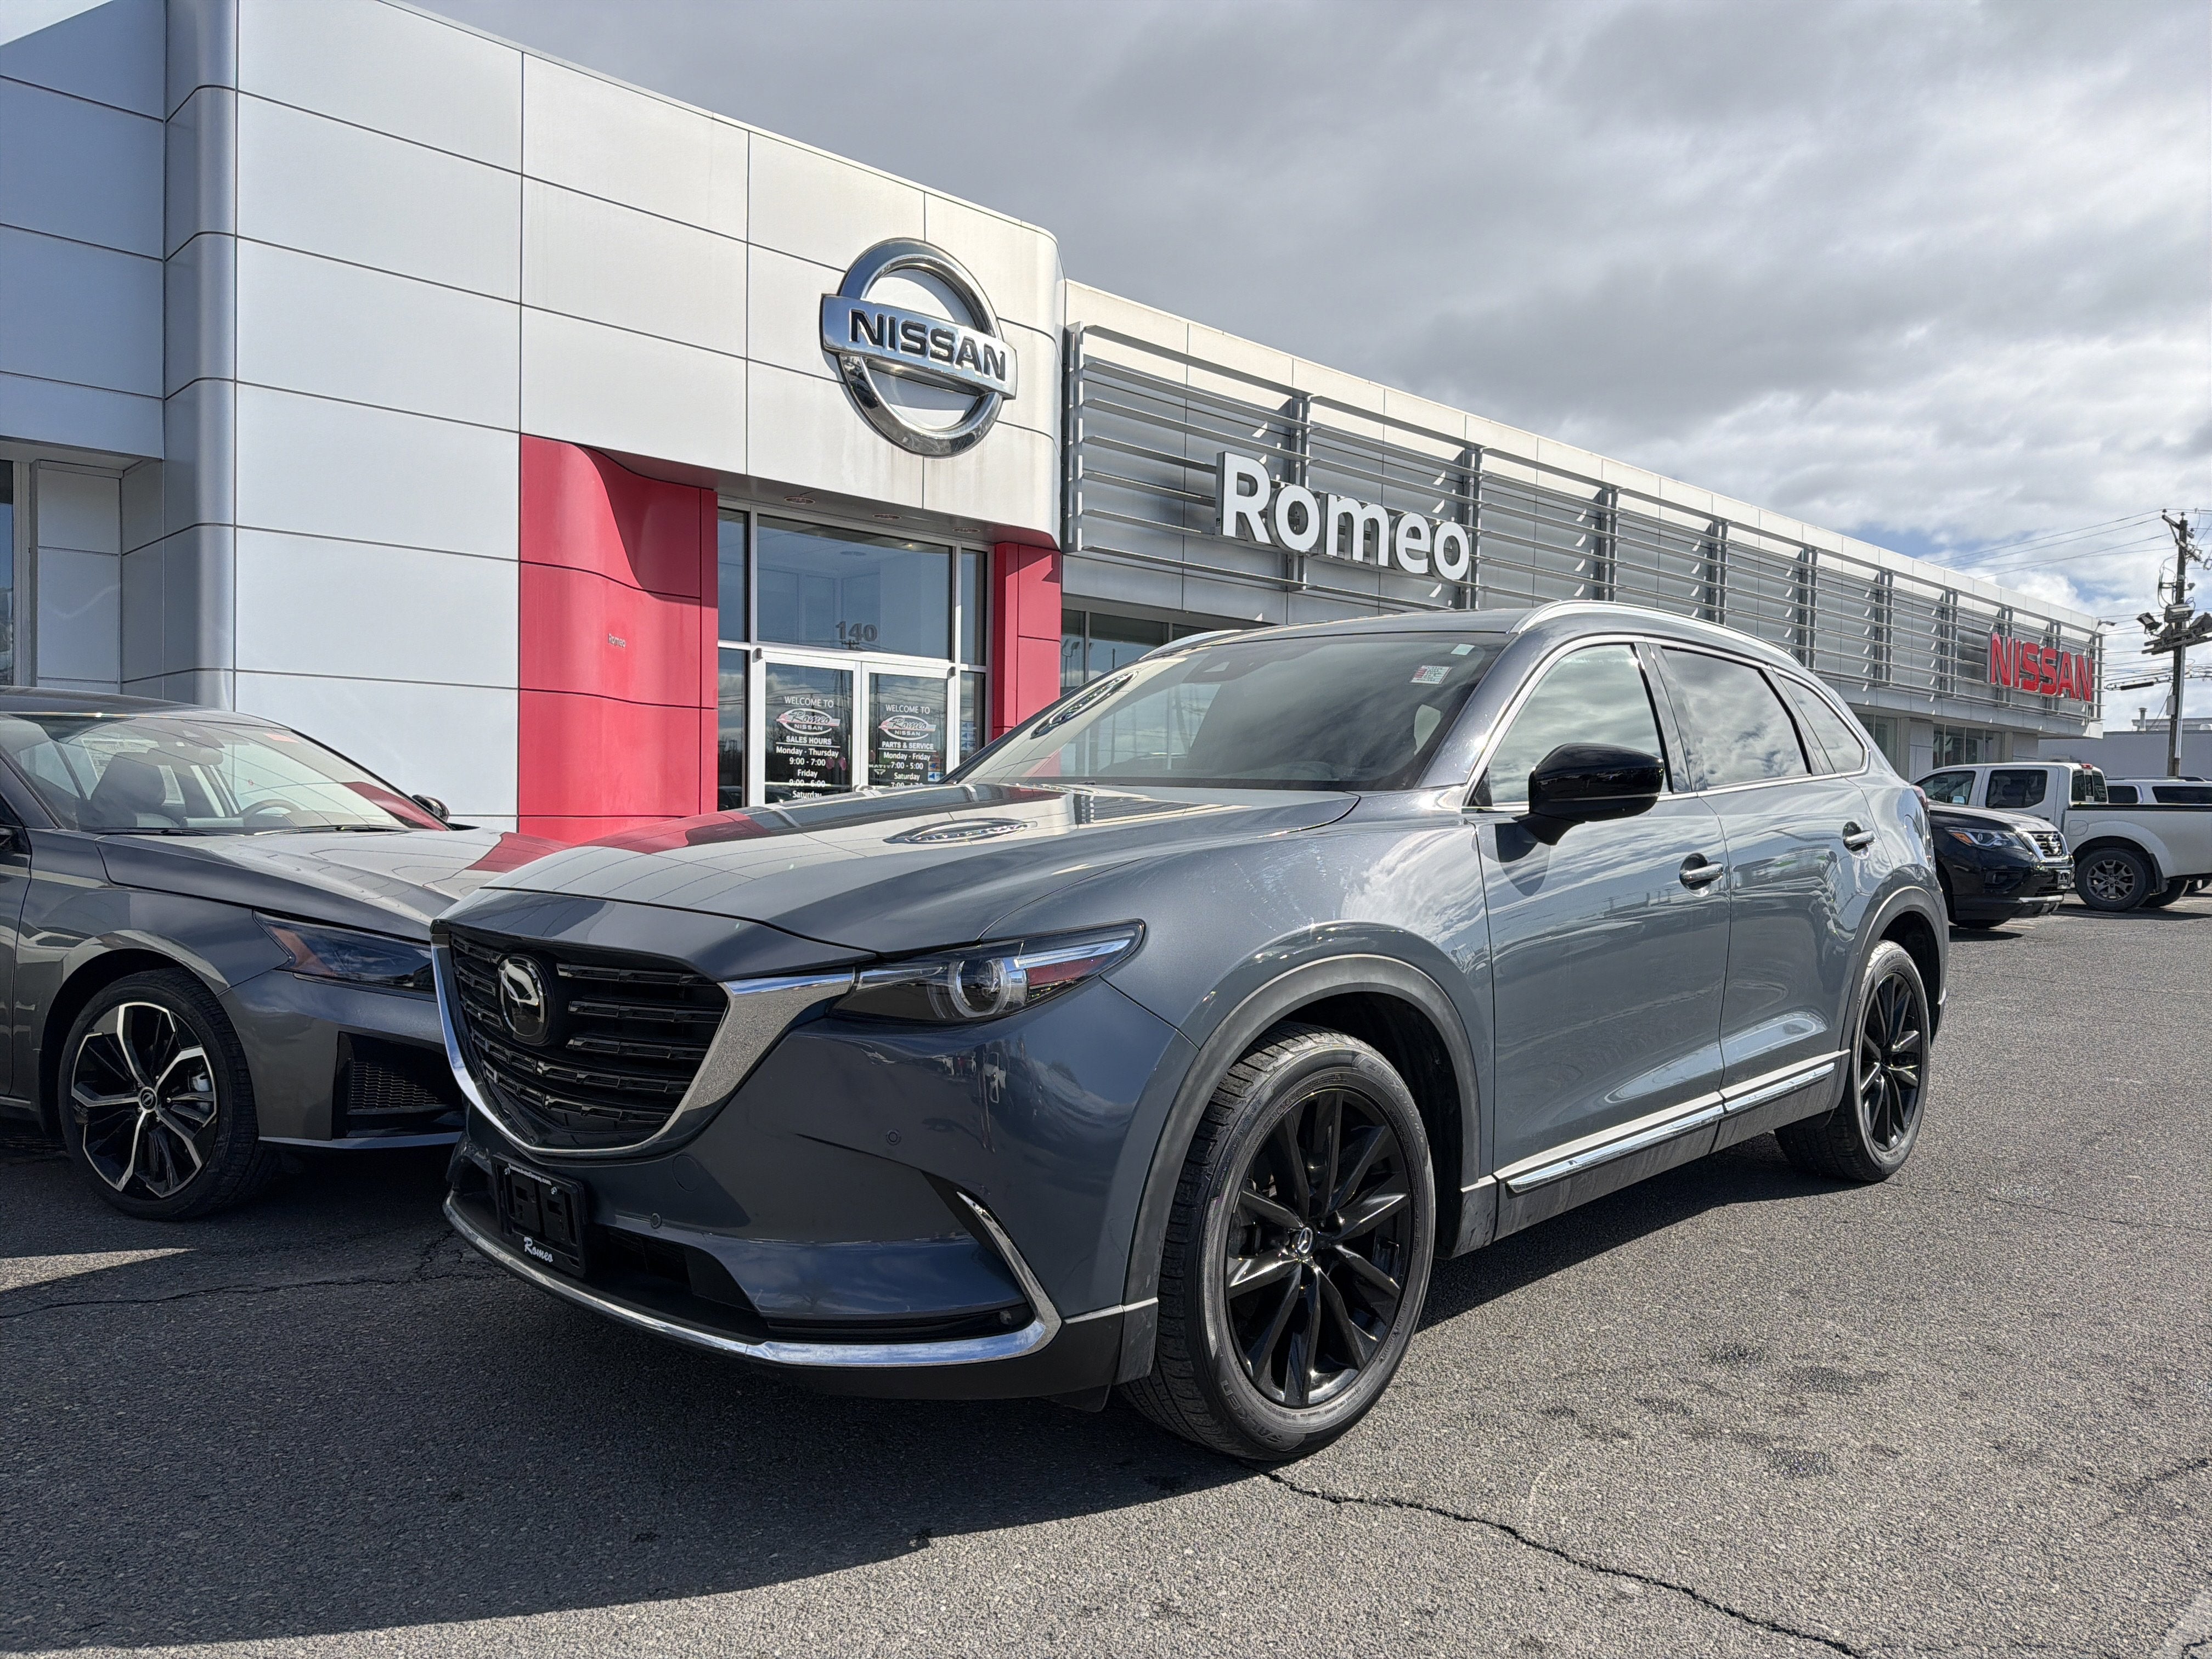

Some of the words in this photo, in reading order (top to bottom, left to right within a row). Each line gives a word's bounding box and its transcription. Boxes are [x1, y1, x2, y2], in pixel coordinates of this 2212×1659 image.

[848, 308, 1007, 383] NISSAN
[1216, 451, 1470, 580] Romeo
[836, 621, 878, 641] 140
[607, 633, 626, 648] Romeo
[1987, 632, 2093, 702] NISSAN
[784, 696, 821, 707] WELCOME
[823, 699, 834, 708] TO
[885, 704, 919, 714] WELCOME
[920, 706, 930, 714] TO
[787, 710, 831, 724] Romeo
[891, 716, 927, 730] Romeo
[786, 735, 808, 744] SALES
[809, 737, 832, 745] HOURS
[776, 746, 803, 756] Monday
[808, 748, 839, 758] Thursday
[883, 751, 908, 761] Monday
[912, 753, 931, 762] Friday
[789, 757, 805, 765] 9:00
[810, 758, 826, 766] 7:00
[890, 761, 905, 769] 7:00
[910, 762, 924, 770] 5:00
[797, 769, 818, 778] Friday
[894, 772, 921, 782] Saturday
[789, 778, 805, 787] 9:00
[810, 780, 826, 788] 6:00
[523, 1235, 554, 1263] Romeo
